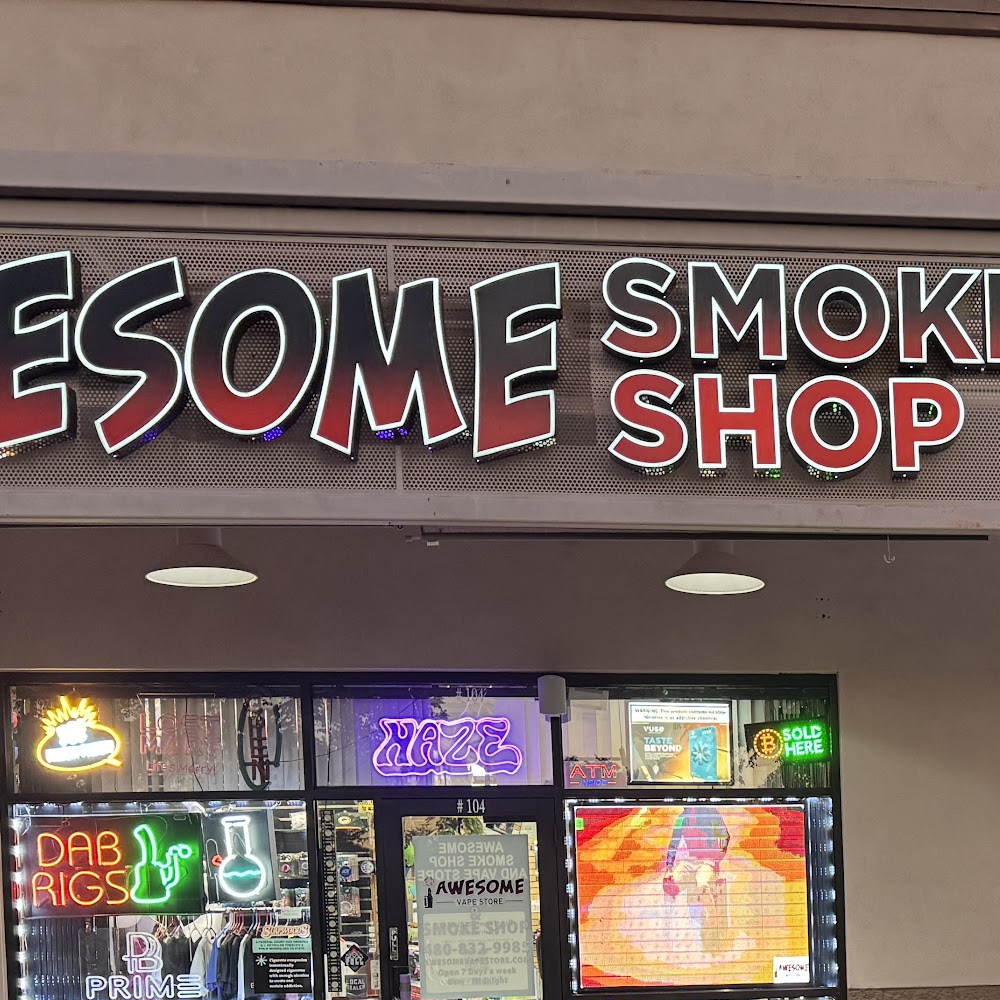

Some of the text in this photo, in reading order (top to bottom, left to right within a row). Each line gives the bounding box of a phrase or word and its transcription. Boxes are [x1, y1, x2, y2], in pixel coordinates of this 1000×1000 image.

[608, 369, 965, 473] SHOP
[140, 713, 221, 734] LOST
[644, 737, 673, 745] TASTE
[783, 725, 822, 741] SOLD
[644, 744, 682, 752] BEYOND
[784, 739, 824, 757] HERE
[570, 764, 617, 778] ATM
[37, 831, 121, 867] DAB
[32, 871, 129, 906] RIGS
[435, 878, 524, 895] AWESOME
